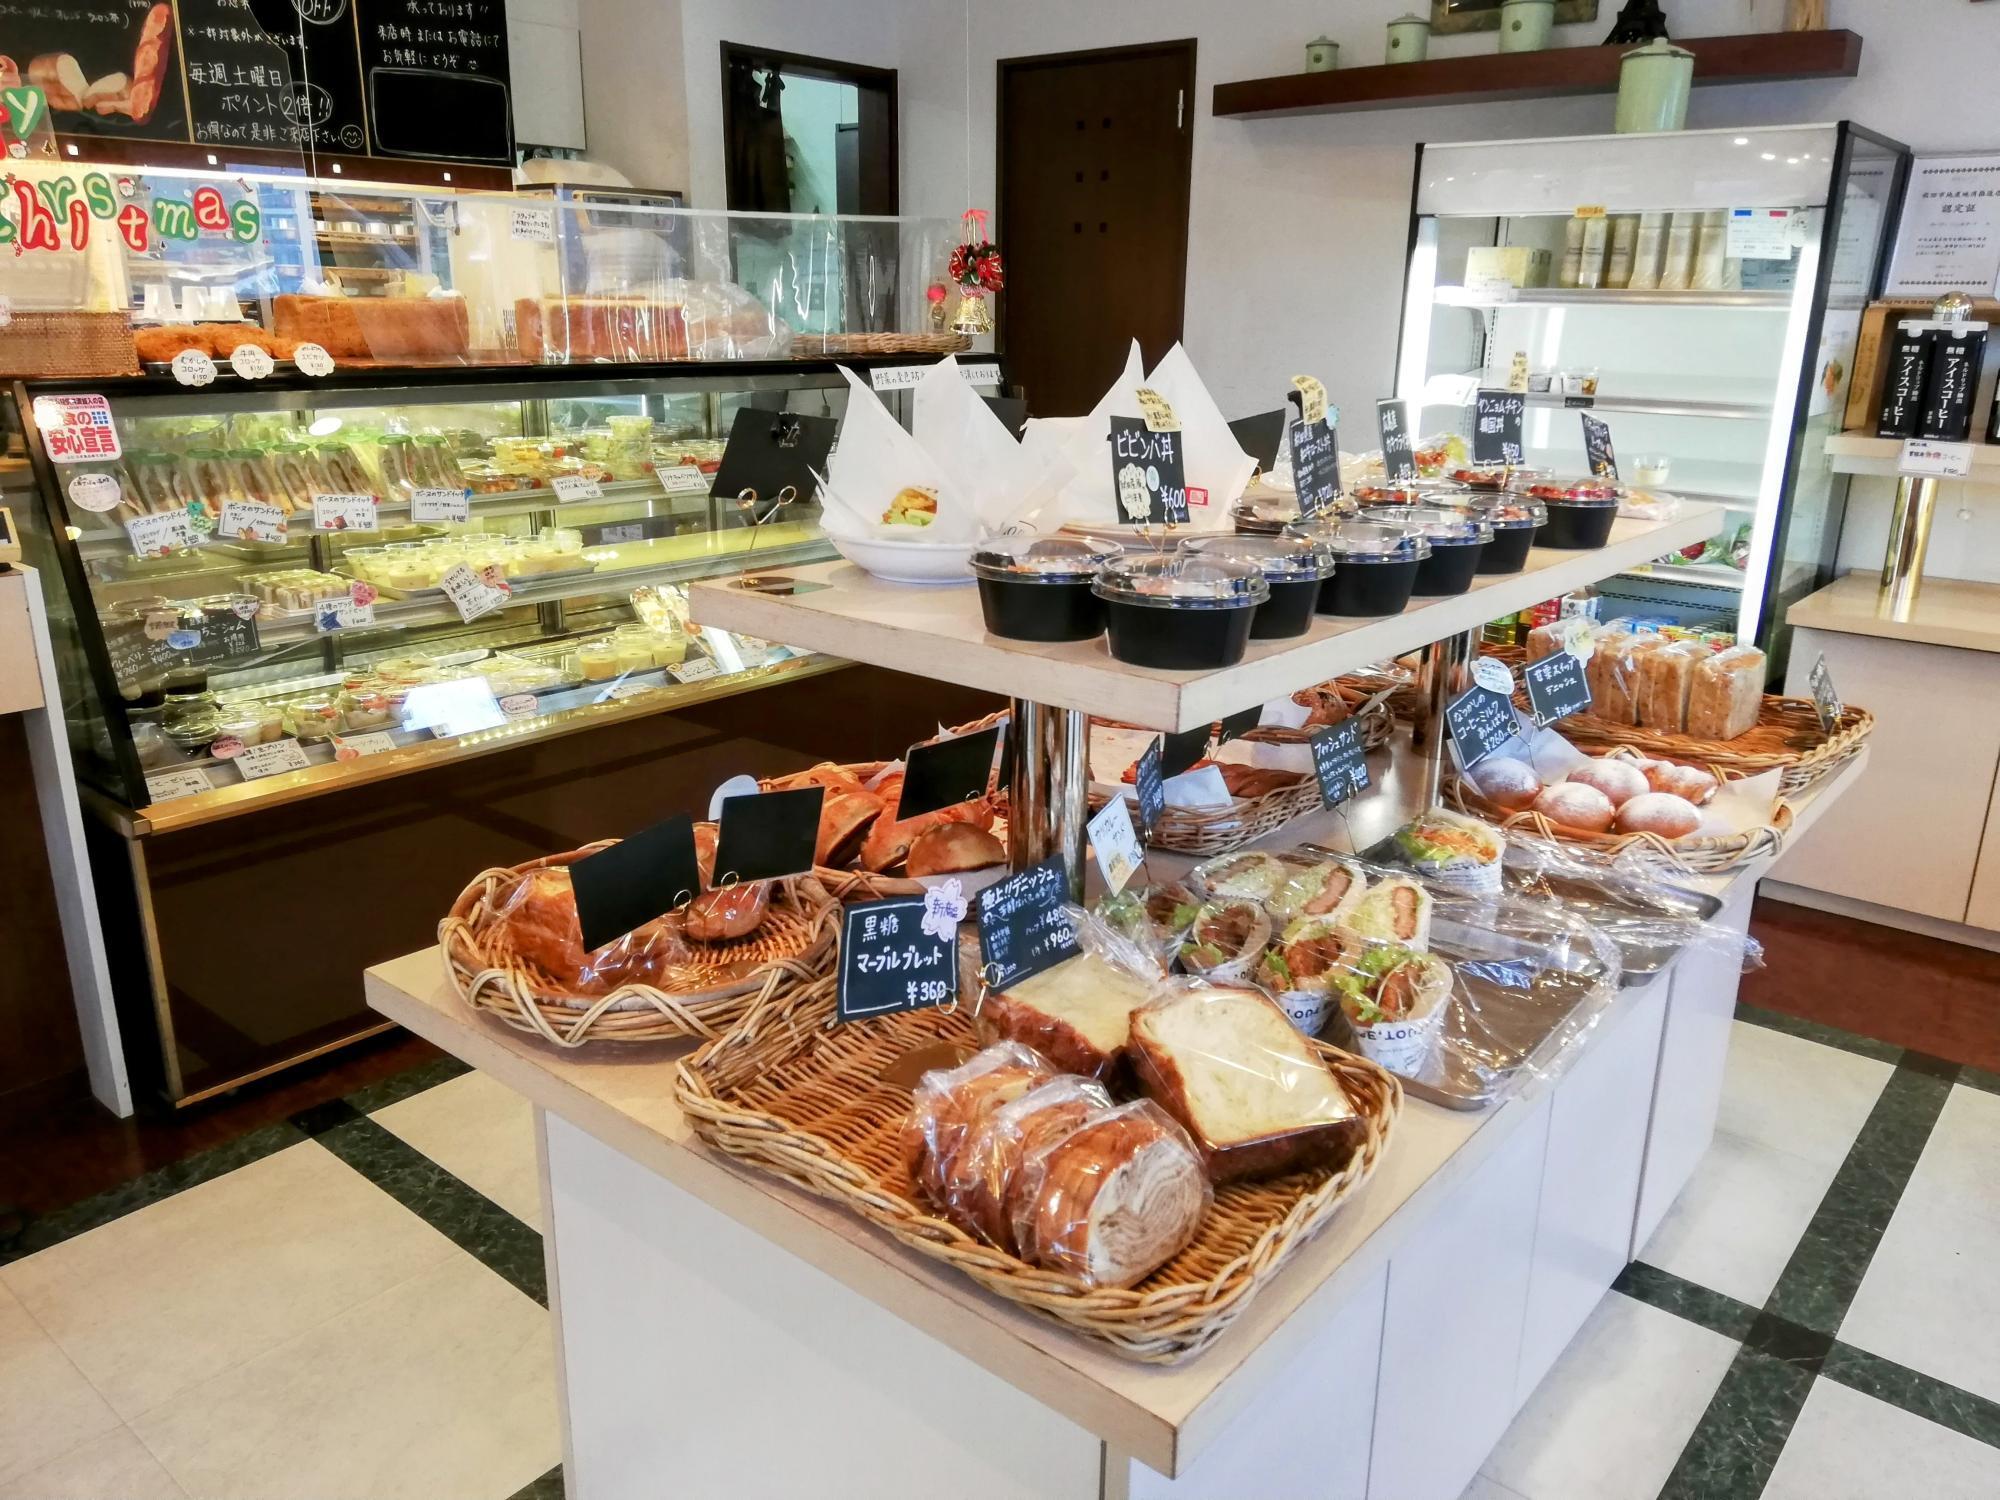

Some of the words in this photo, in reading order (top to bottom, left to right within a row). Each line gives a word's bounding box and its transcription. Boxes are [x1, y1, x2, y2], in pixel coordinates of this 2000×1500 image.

[189, 61, 283, 87] 毎週土曜日
[1941, 203, 1976, 213] 認定証
[1945, 347, 1965, 355] 無糖
[1894, 356, 1915, 427] アイスコーヒー
[1938, 358, 1961, 430] アイスコーヒー
[48, 426, 117, 457] 安心宣言
[1117, 428, 1174, 464] ビビンバ丼
[1159, 485, 1187, 510] ¥600
[1457, 700, 1499, 740] コーヒーミルク
[1478, 710, 1510, 740] あんぱん
[1482, 729, 1505, 752] ¥260
[862, 912, 900, 943] 黒糖
[1043, 927, 1071, 952] ¥960
[856, 945, 943, 974] マーブルブレット
[906, 980, 947, 1007] ¥360
